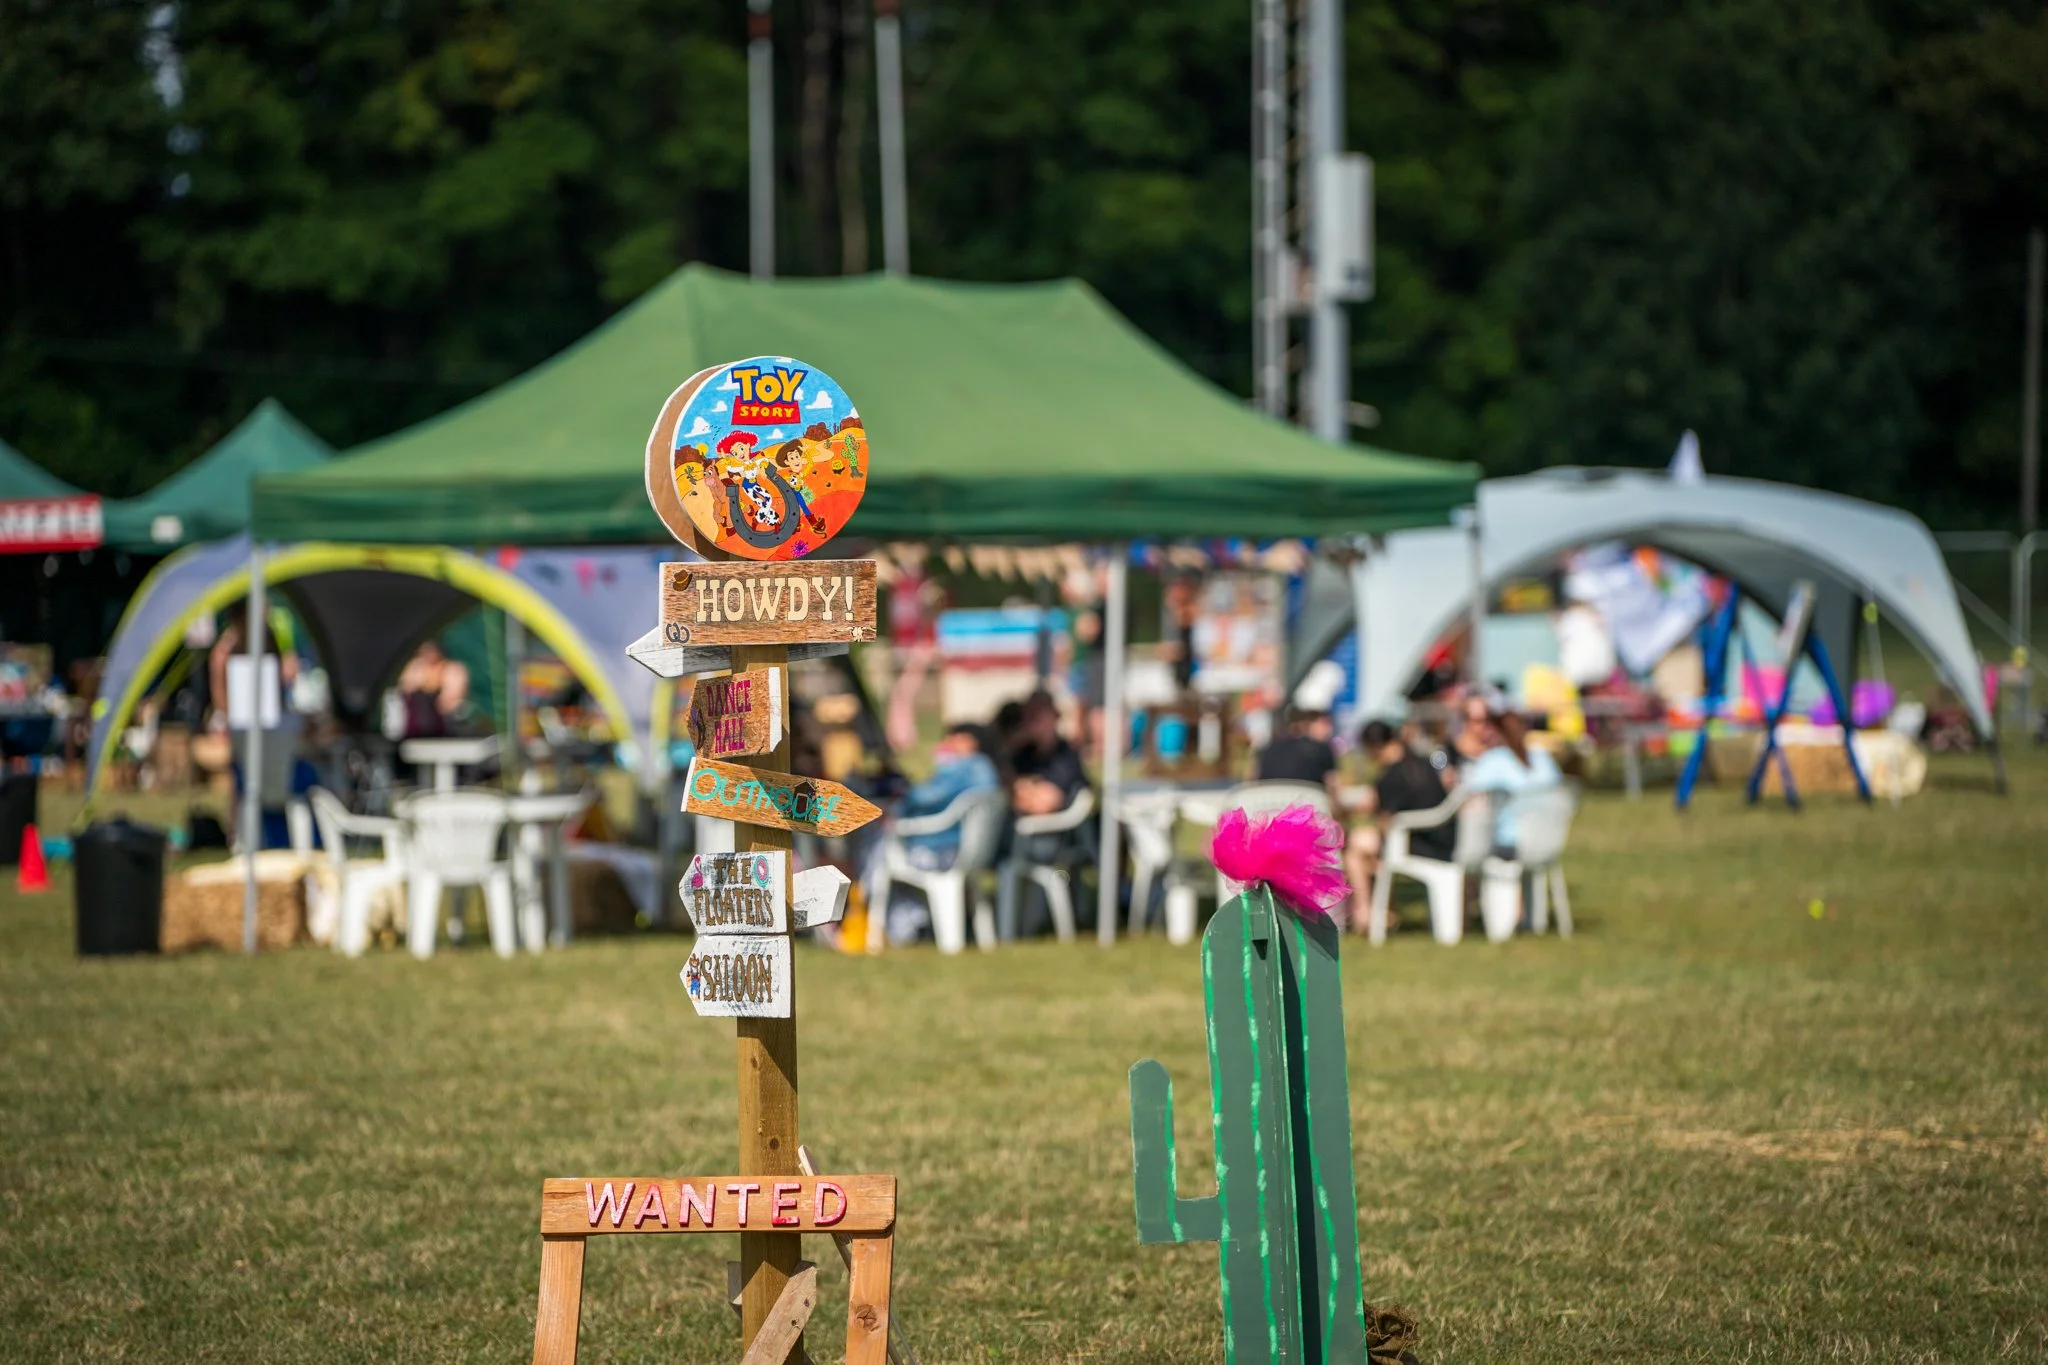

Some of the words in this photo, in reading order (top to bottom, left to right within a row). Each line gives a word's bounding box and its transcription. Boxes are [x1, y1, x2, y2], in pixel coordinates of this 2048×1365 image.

[732, 366, 808, 405] TOY
[739, 405, 796, 419] STORY
[695, 576, 854, 623] HOWDY!
[706, 679, 752, 718] DANCE
[714, 718, 745, 754] HALL
[690, 767, 843, 822] OUTHOUSE
[714, 857, 753, 885] THE
[694, 887, 775, 927] FLOATERS
[701, 954, 773, 1003] SALOON
[584, 1181, 848, 1228] WANTED
